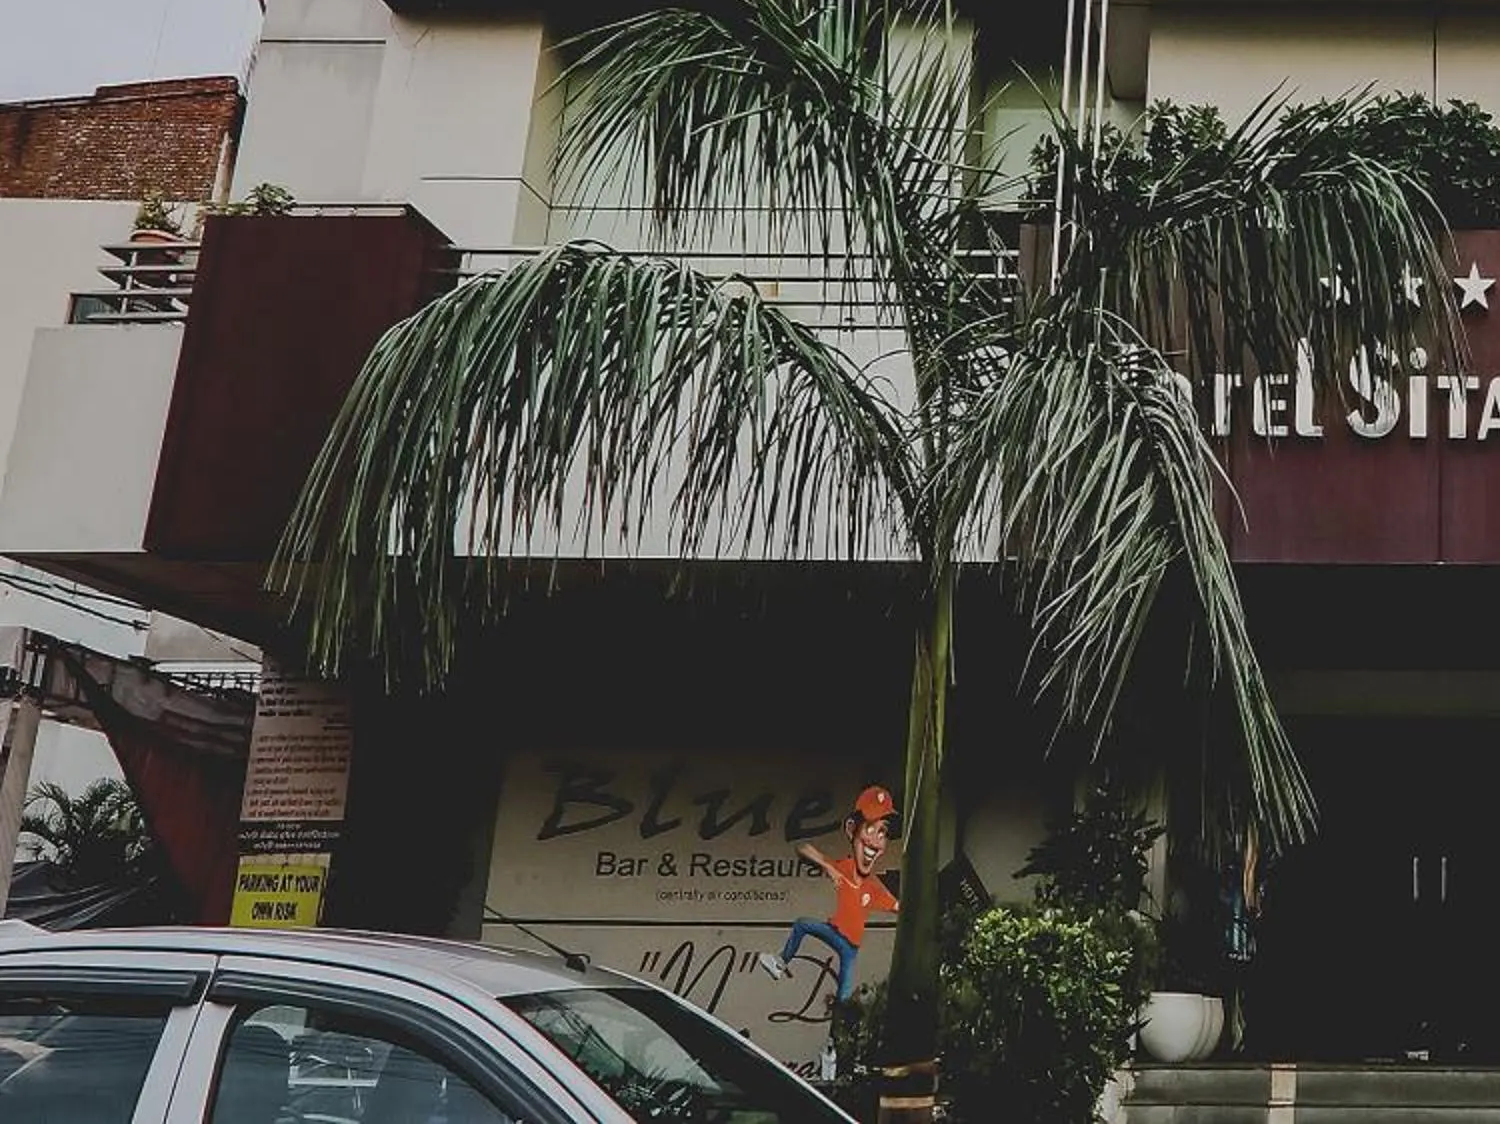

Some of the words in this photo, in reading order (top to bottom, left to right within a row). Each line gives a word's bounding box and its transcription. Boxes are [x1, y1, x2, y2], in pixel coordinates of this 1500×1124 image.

[595, 852, 648, 877] Bar
[657, 853, 678, 877] &
[689, 853, 831, 877] Restaura
[238, 873, 279, 893] PARKING
[280, 873, 295, 893] AT
[295, 873, 320, 893] YOUR
[251, 901, 275, 921] OWN
[275, 901, 299, 921] RISK
